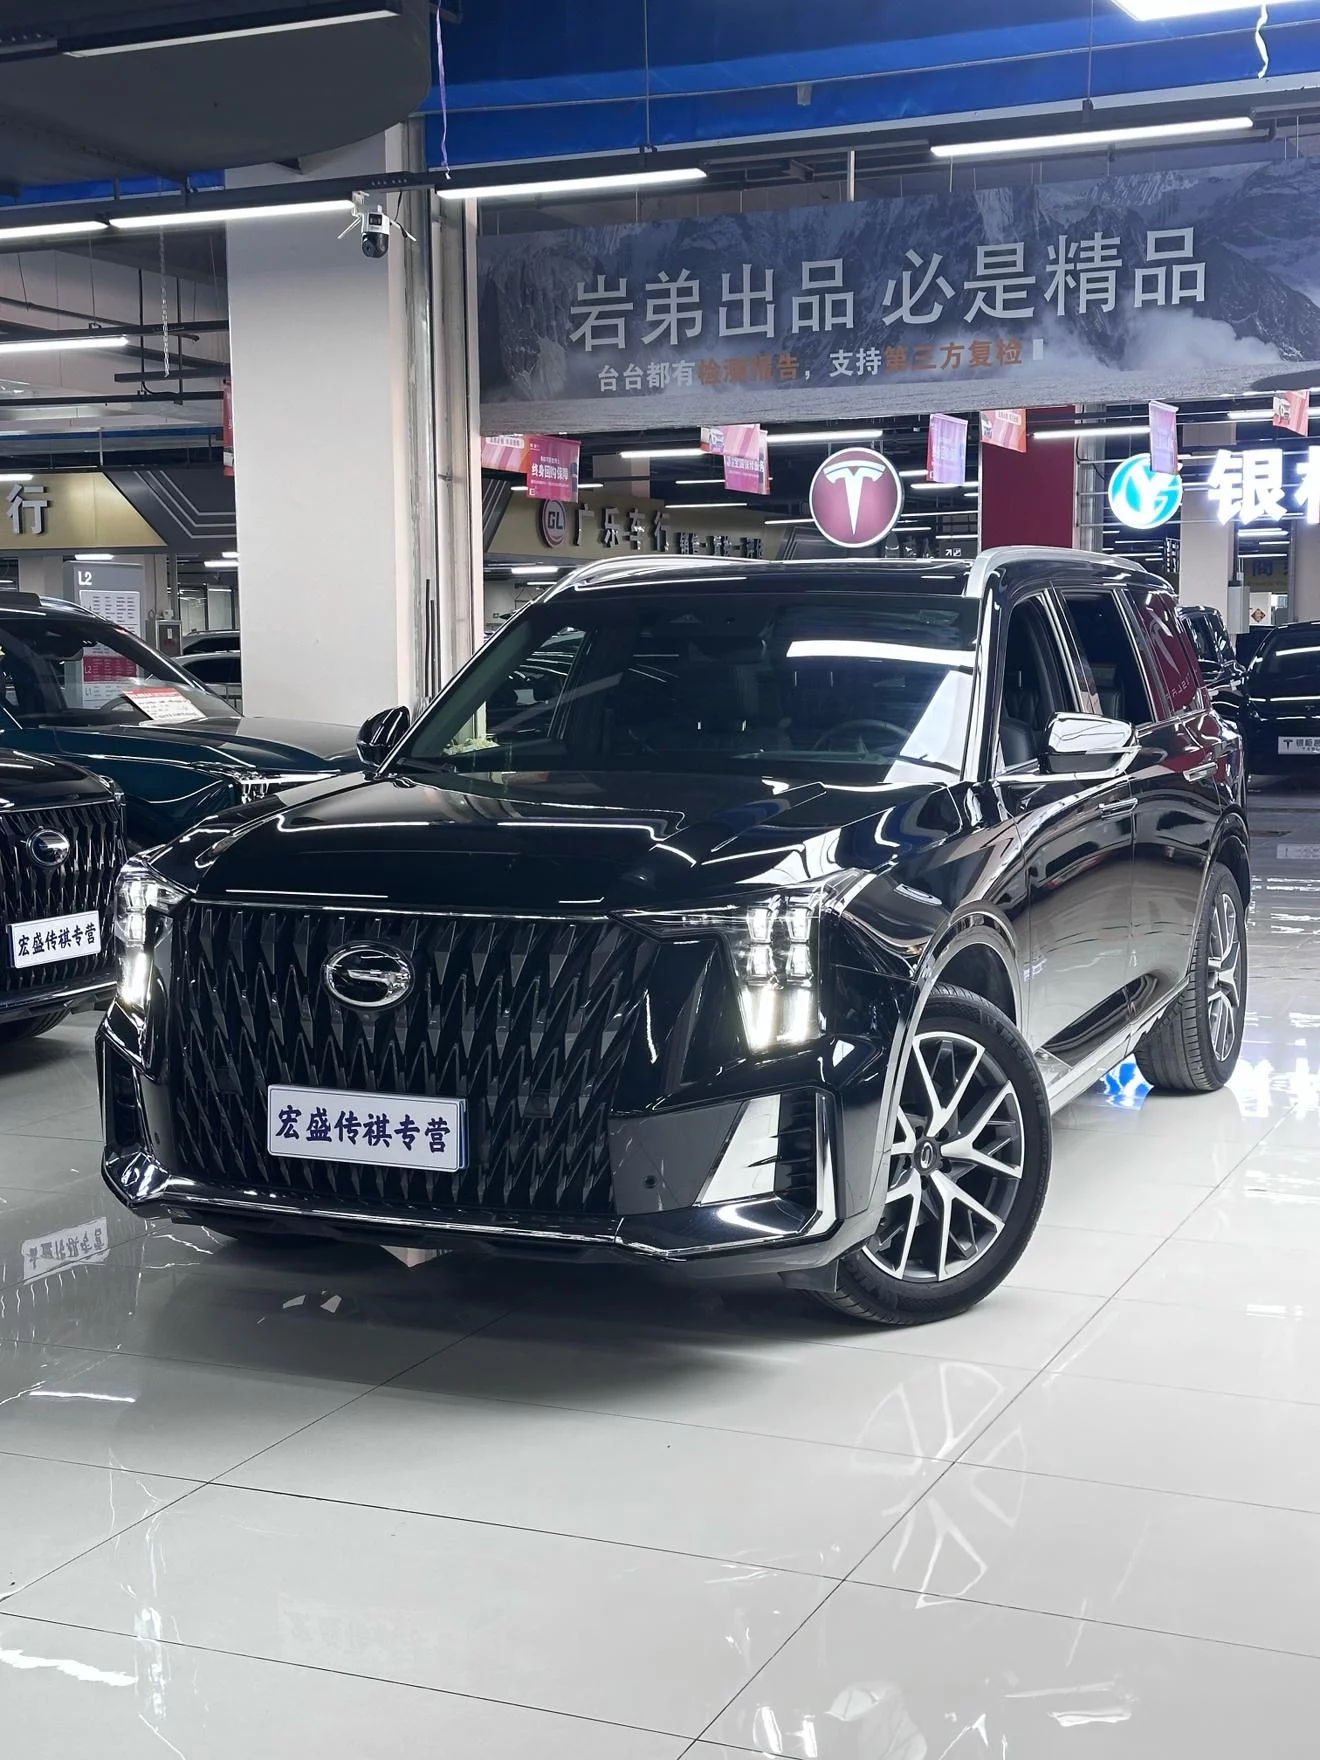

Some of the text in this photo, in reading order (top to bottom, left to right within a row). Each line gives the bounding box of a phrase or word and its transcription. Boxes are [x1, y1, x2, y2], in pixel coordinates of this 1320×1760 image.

[569, 227, 1206, 352] 岩弟出品 必是精品
[7, 484, 48, 534] 行
[547, 511, 564, 530] GL
[577, 503, 672, 552] 广乐车行
[78, 571, 93, 585] L2
[18, 922, 96, 957] 宏盛传祺专营
[275, 1104, 451, 1153] 宏盛传祺专营
